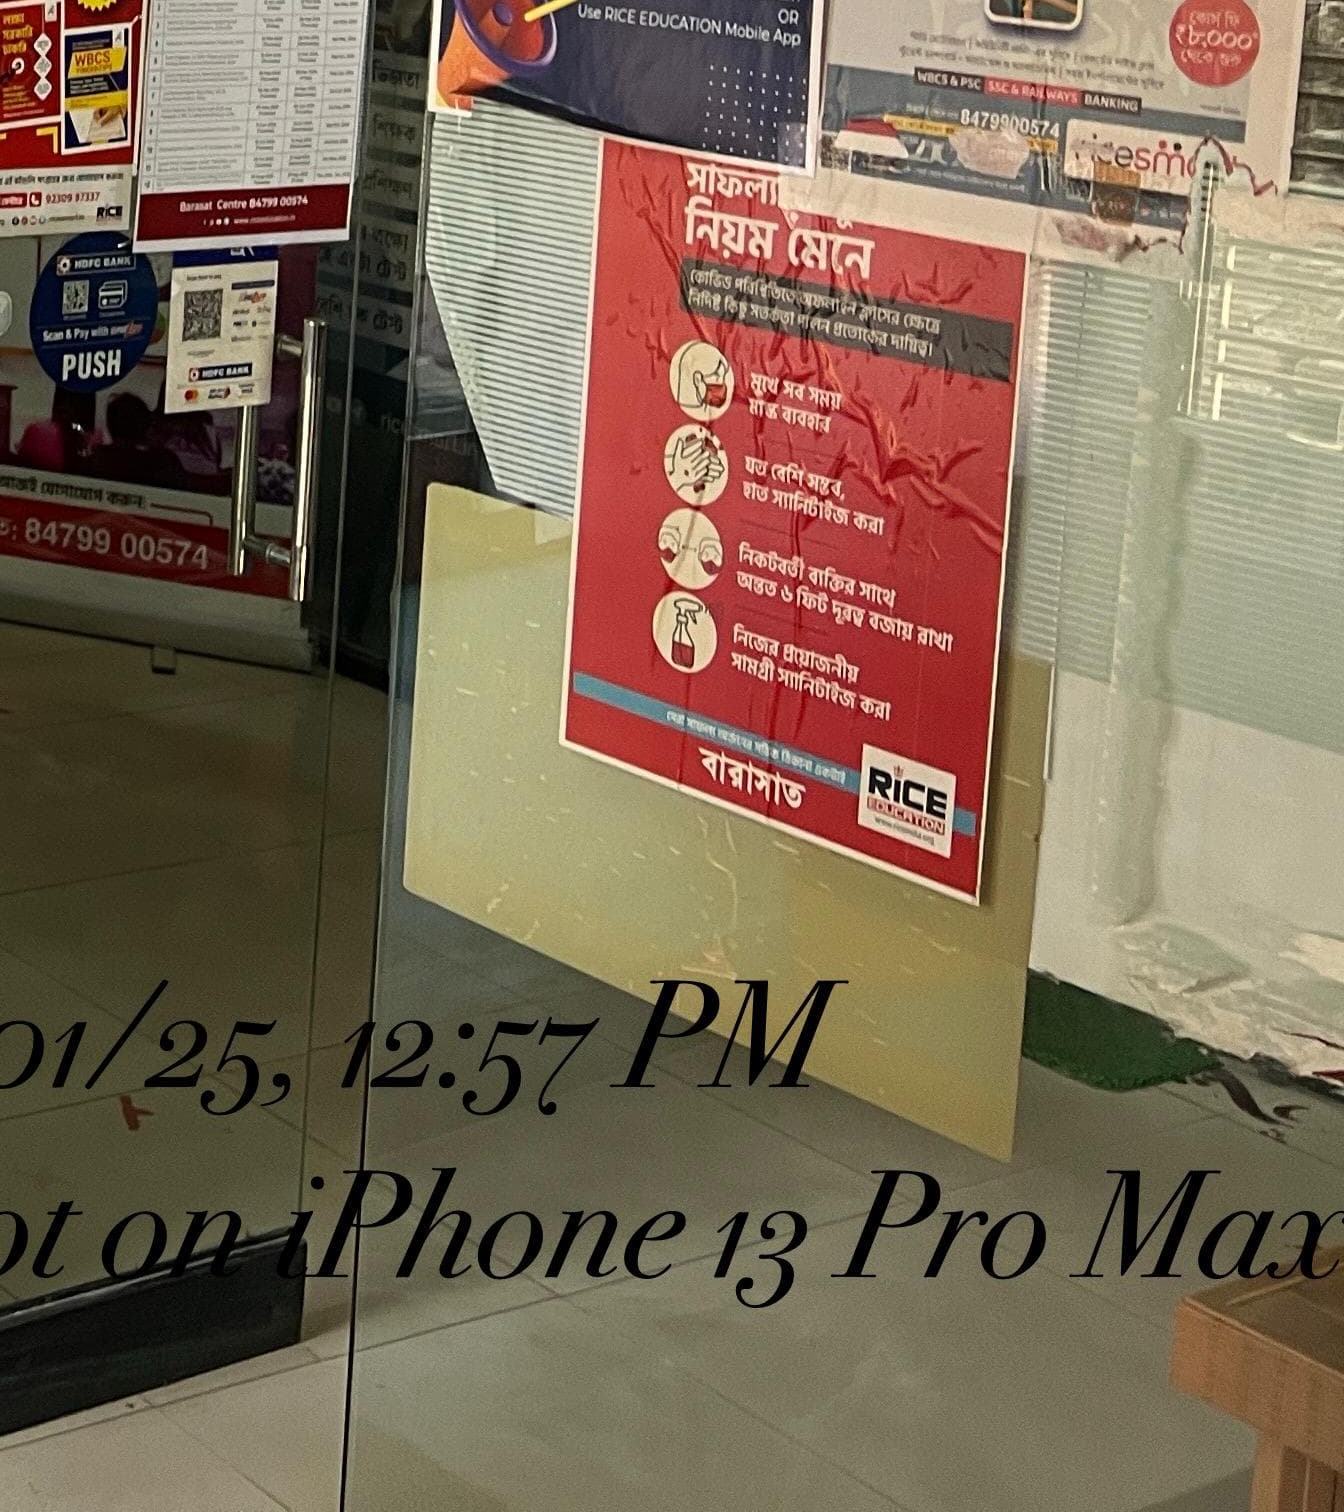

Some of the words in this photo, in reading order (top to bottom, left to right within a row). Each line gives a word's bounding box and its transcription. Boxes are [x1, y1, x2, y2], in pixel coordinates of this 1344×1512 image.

[578, 4, 602, 19] Use
[604, 6, 635, 24] RICE
[639, 10, 721, 35] EDUCATION
[725, 21, 770, 41] Mobile
[773, 28, 800, 47] App
[778, 9, 798, 25] OR
[917, 70, 949, 86] WBCS
[1084, 93, 1139, 111] BANKING
[960, 108, 1060, 138] 8479900574
[217, 199, 247, 209] Centre
[685, 196, 779, 259] নিয়ম
[788, 228, 875, 279] মেনে
[75, 259, 101, 270] HDFC
[104, 256, 131, 267] BANK
[43, 329, 64, 342] Scan
[62, 350, 122, 381] PUSH
[227, 366, 249, 377] BANK
[783, 380, 805, 401] সব
[809, 386, 841, 410] সময়
[744, 456, 768, 475] যত
[771, 462, 804, 486] বেশি
[742, 481, 769, 501] হাত
[772, 489, 850, 526] স্যানিটাইজ
[853, 509, 884, 535] করা
[25, 518, 110, 555] 84799
[121, 533, 208, 570] 00574
[698, 747, 806, 809] বারাসাত
[867, 797, 945, 835] EDUCATION
